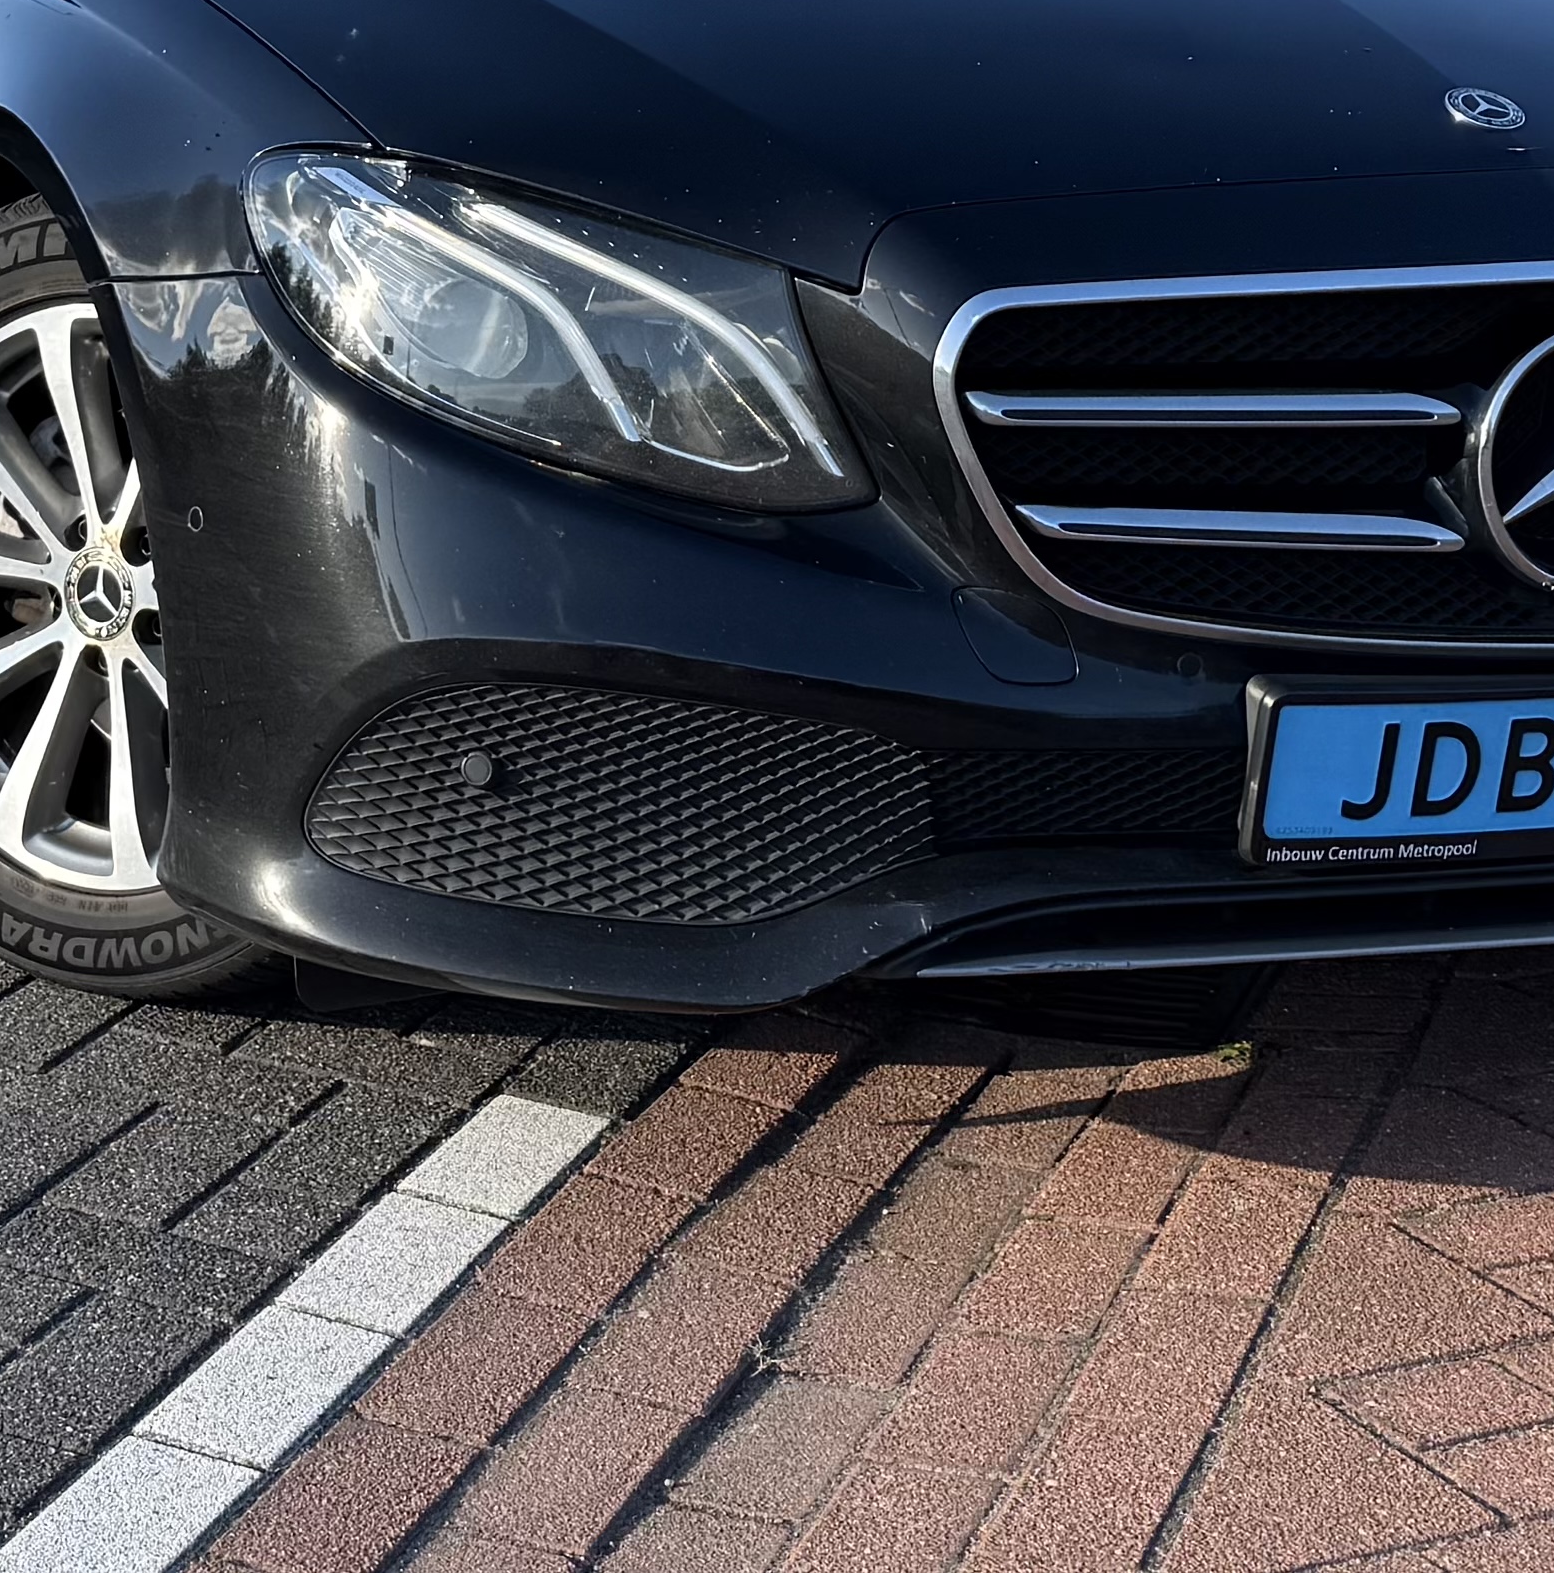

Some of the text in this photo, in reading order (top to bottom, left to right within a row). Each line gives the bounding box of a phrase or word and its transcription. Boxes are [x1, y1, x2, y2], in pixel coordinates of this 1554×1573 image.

[1266, 839, 1478, 862] Inbouw Centrum Metropool
